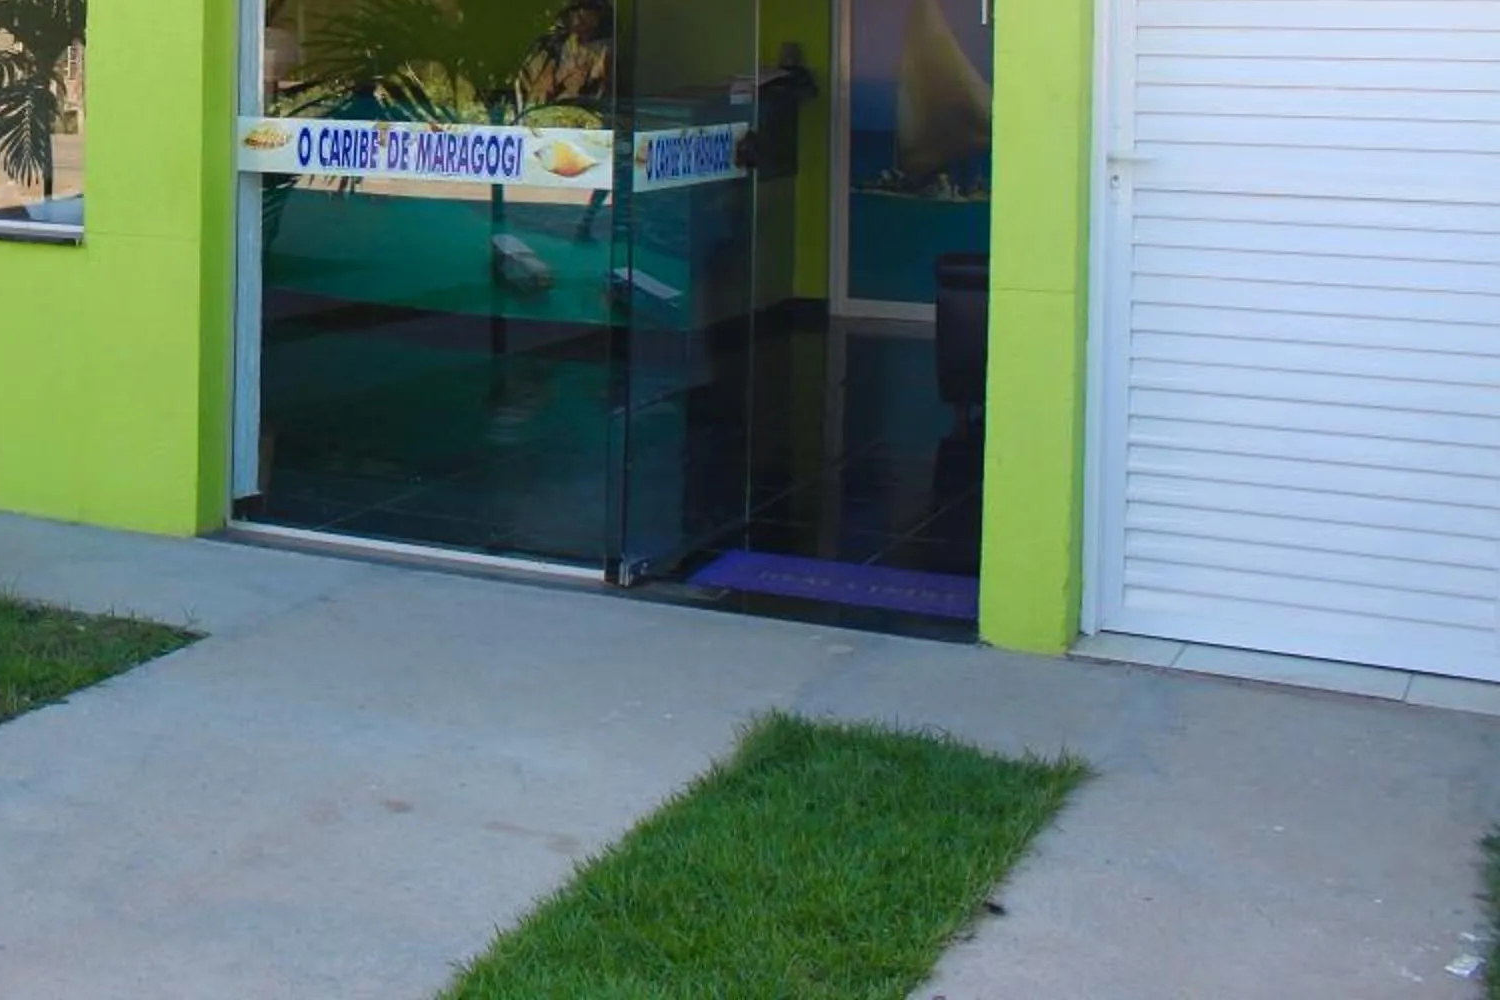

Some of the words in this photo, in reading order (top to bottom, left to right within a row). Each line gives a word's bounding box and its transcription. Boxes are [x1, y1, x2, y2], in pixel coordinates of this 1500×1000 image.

[297, 127, 312, 167] O
[318, 127, 379, 169] CARIBE
[387, 131, 410, 171] DE
[415, 132, 524, 177] MARAGOGI
